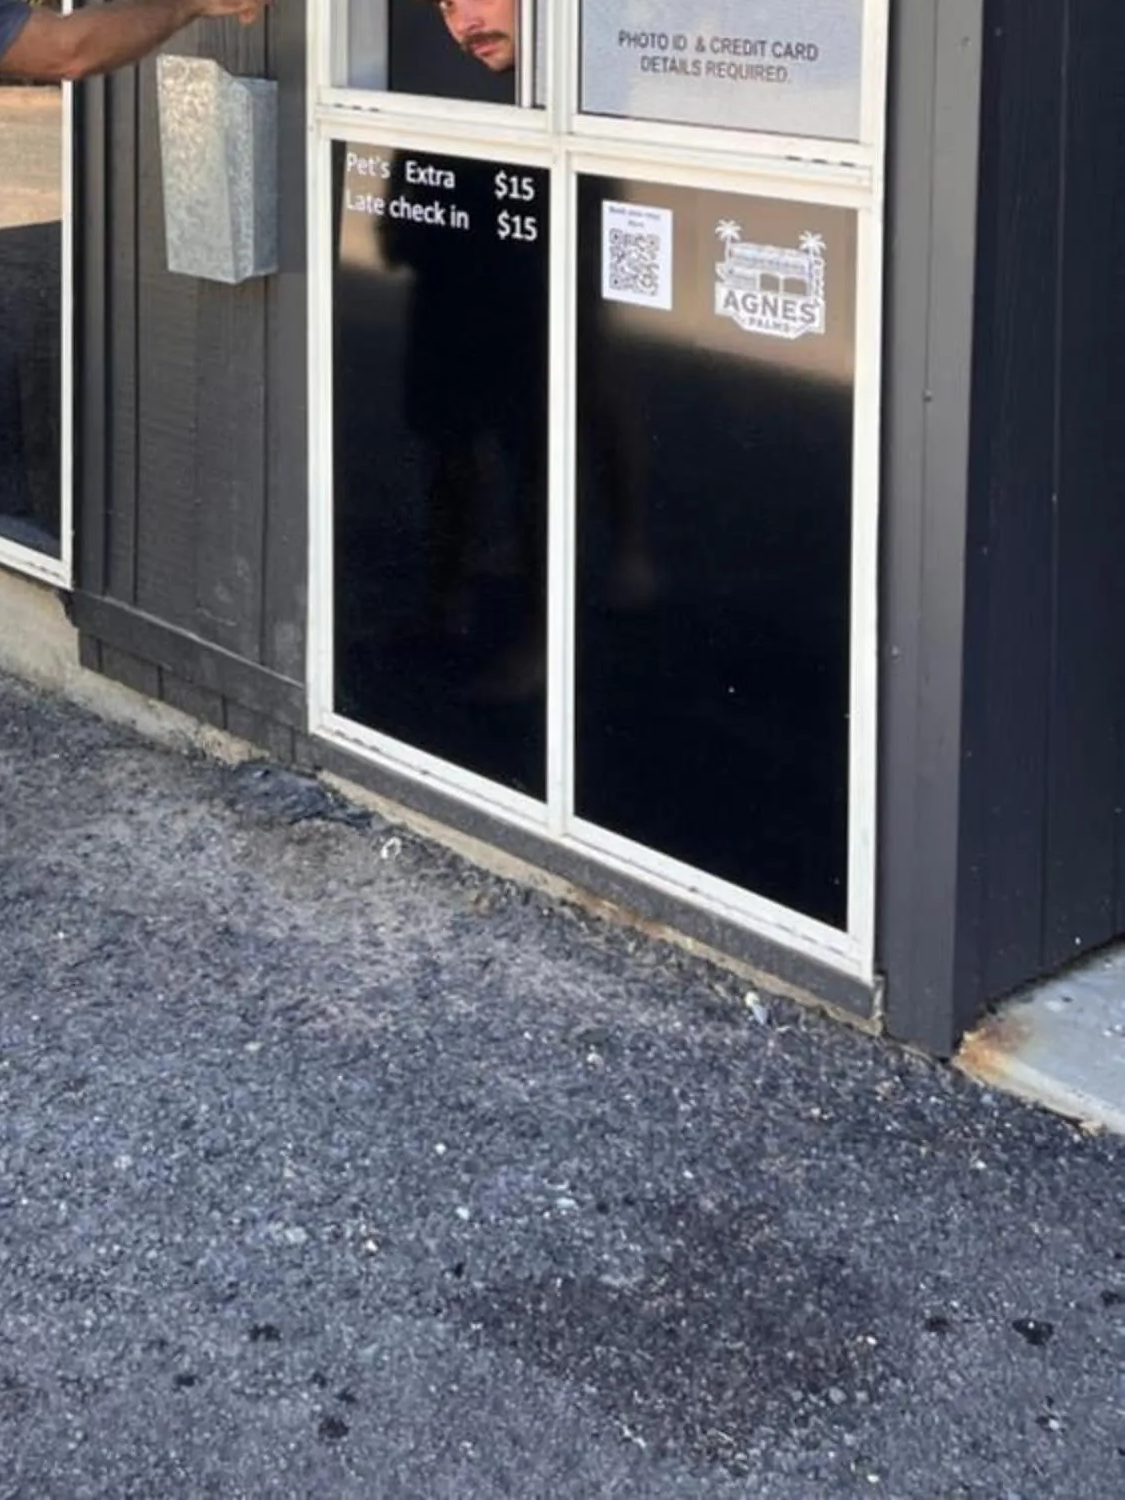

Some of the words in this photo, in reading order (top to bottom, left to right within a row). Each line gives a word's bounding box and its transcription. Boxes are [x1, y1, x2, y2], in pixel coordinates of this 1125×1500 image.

[618, 30, 669, 50] PHOTO
[672, 34, 688, 49] ID
[694, 35, 706, 52] &
[709, 36, 767, 57] CREDIT
[771, 41, 819, 61] CARD
[640, 55, 702, 77] DETAILS
[345, 152, 391, 179] Pet's
[405, 161, 456, 189] Extra
[494, 170, 535, 201] $15
[345, 190, 385, 216] Late
[388, 196, 445, 227] check
[450, 204, 470, 231] in
[497, 209, 538, 241] $15
[723, 289, 816, 324] AGNES
